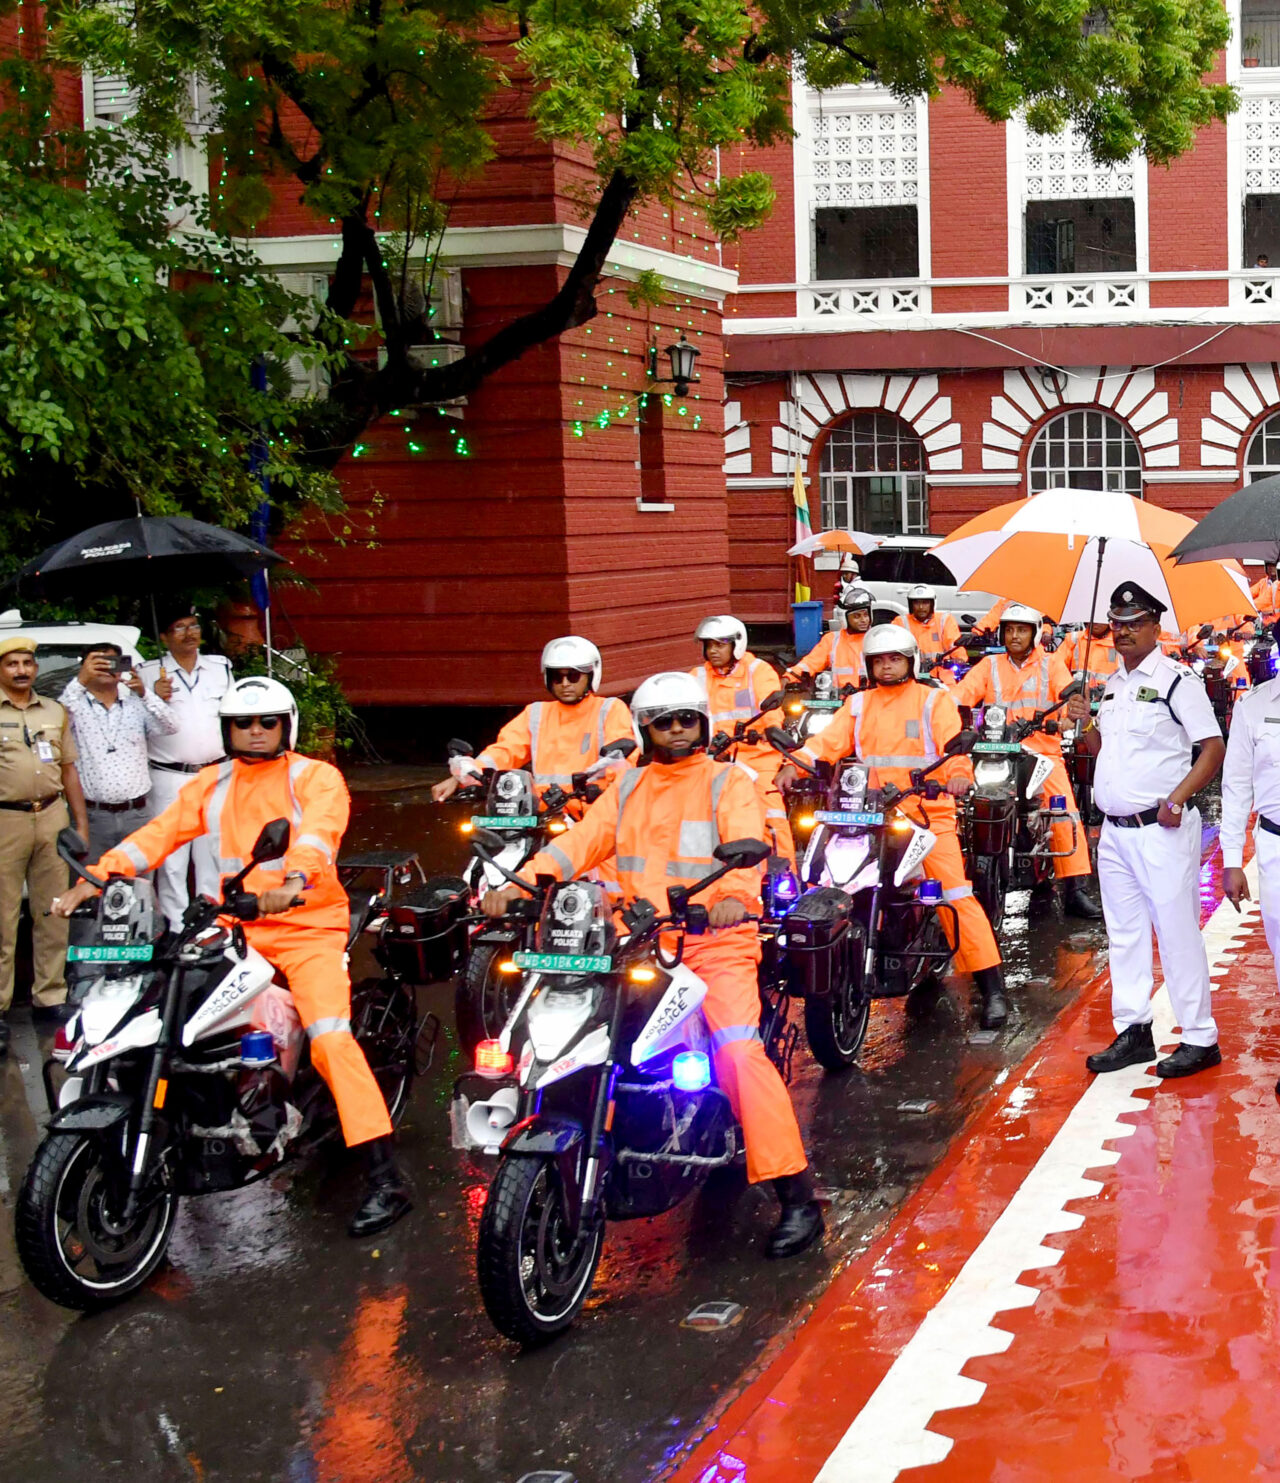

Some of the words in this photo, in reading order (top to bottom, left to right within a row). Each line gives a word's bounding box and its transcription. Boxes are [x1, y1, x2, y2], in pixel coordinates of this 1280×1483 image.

[551, 930, 583, 938] KOLKATA
[553, 939, 579, 947] POLICE
[198, 970, 252, 1020] KOLKATA
[211, 983, 249, 1015] POLICE
[645, 986, 690, 1040] KOLKATA
[657, 1000, 688, 1035] POLICE
